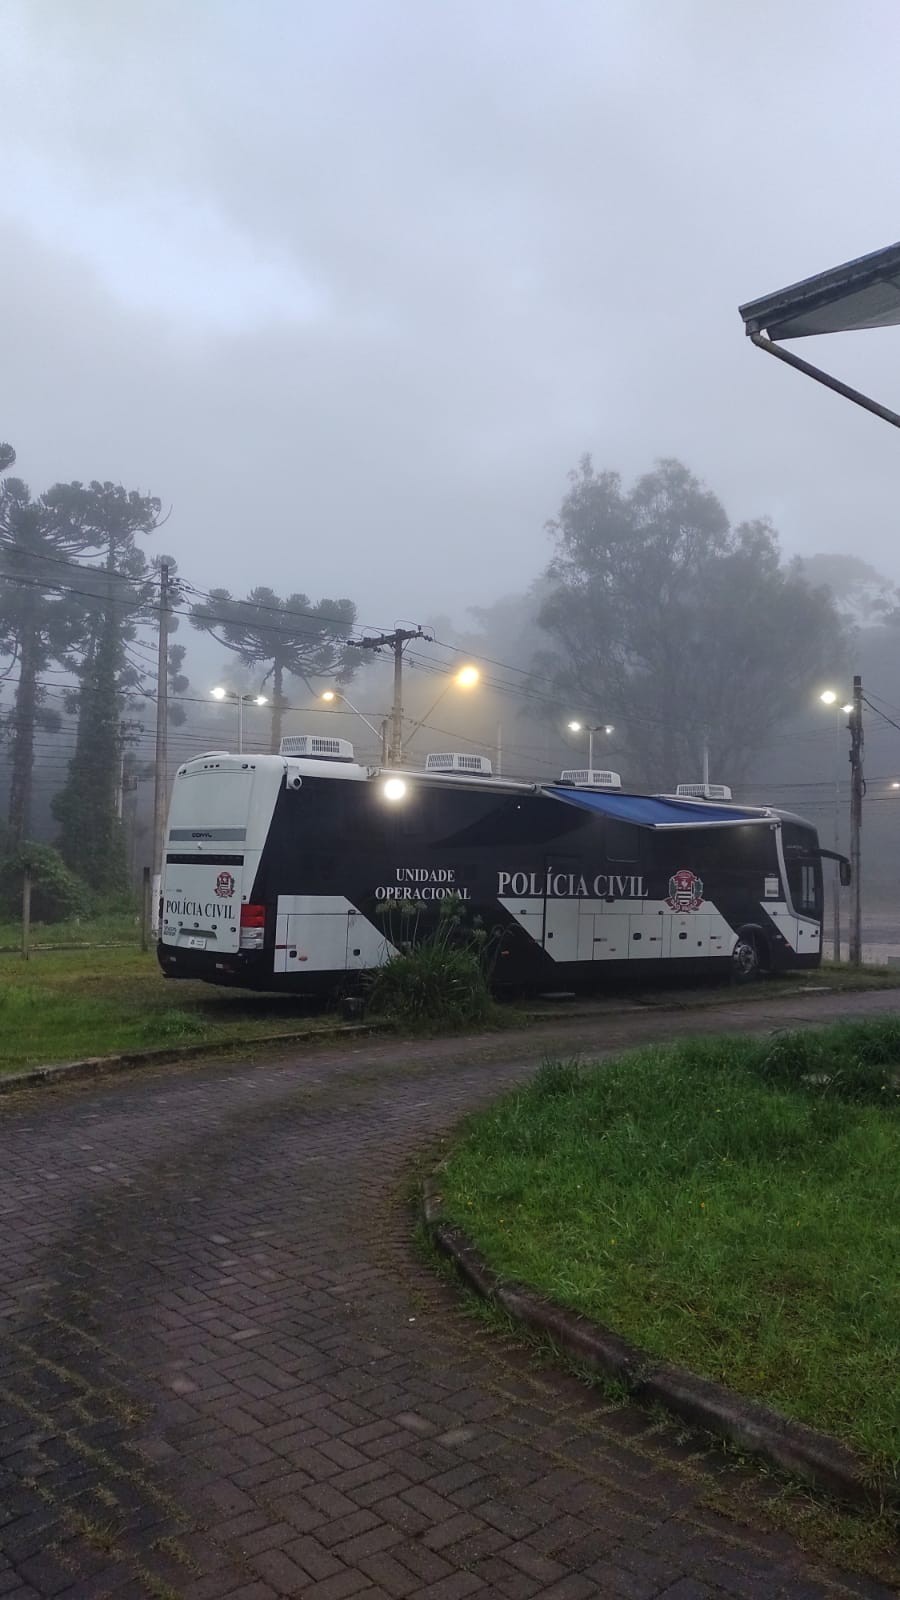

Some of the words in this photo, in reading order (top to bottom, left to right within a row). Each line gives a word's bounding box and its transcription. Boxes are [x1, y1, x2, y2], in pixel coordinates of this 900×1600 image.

[396, 868, 455, 882] UNIDADE
[497, 866, 589, 896] POLÍCIA
[593, 875, 649, 897] CIVIL
[375, 886, 471, 900] OPERACIONAL
[166, 897, 202, 917] POLÍCIA
[205, 903, 235, 920] CIVIL
